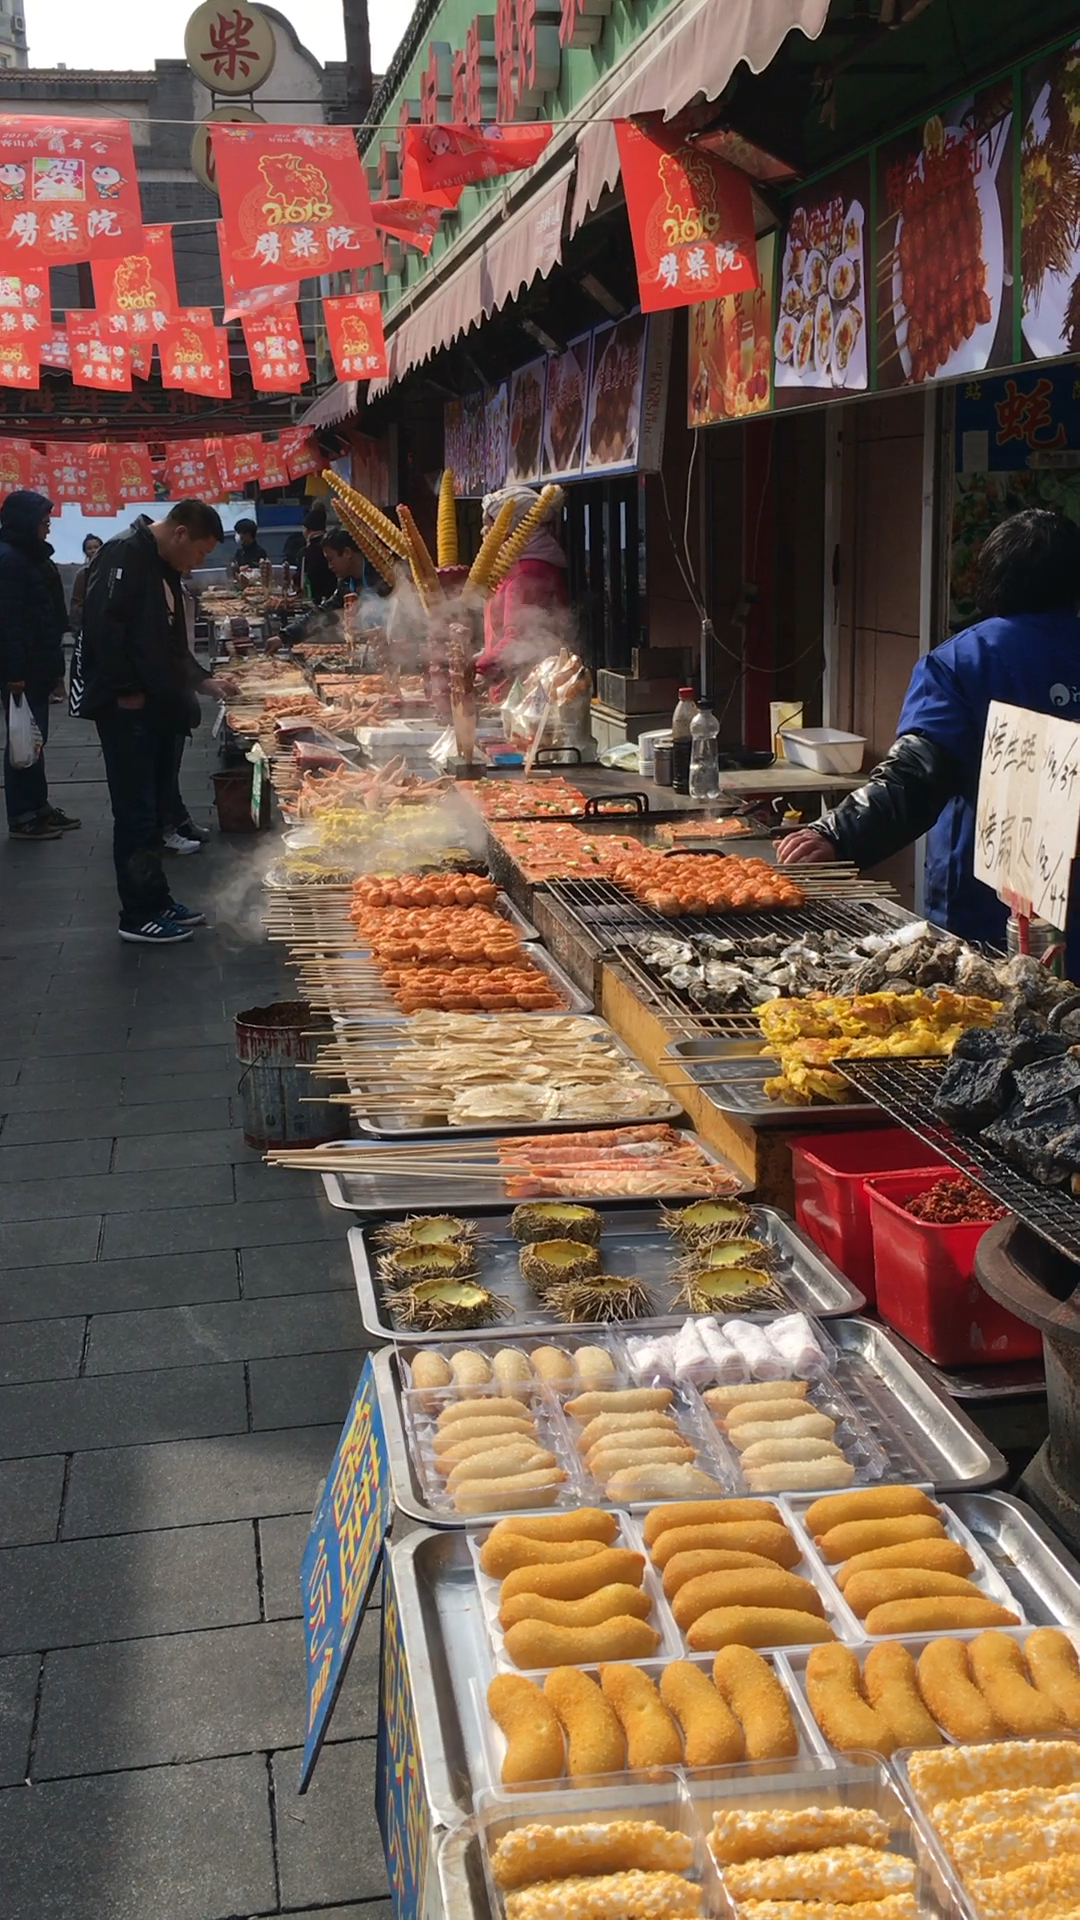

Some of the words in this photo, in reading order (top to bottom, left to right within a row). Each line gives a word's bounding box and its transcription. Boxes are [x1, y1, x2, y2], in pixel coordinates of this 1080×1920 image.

[200, 9, 260, 80] 柴
[261, 202, 333, 226] 2019
[663, 213, 720, 247] 2019
[994, 379, 1067, 449] 蚝
